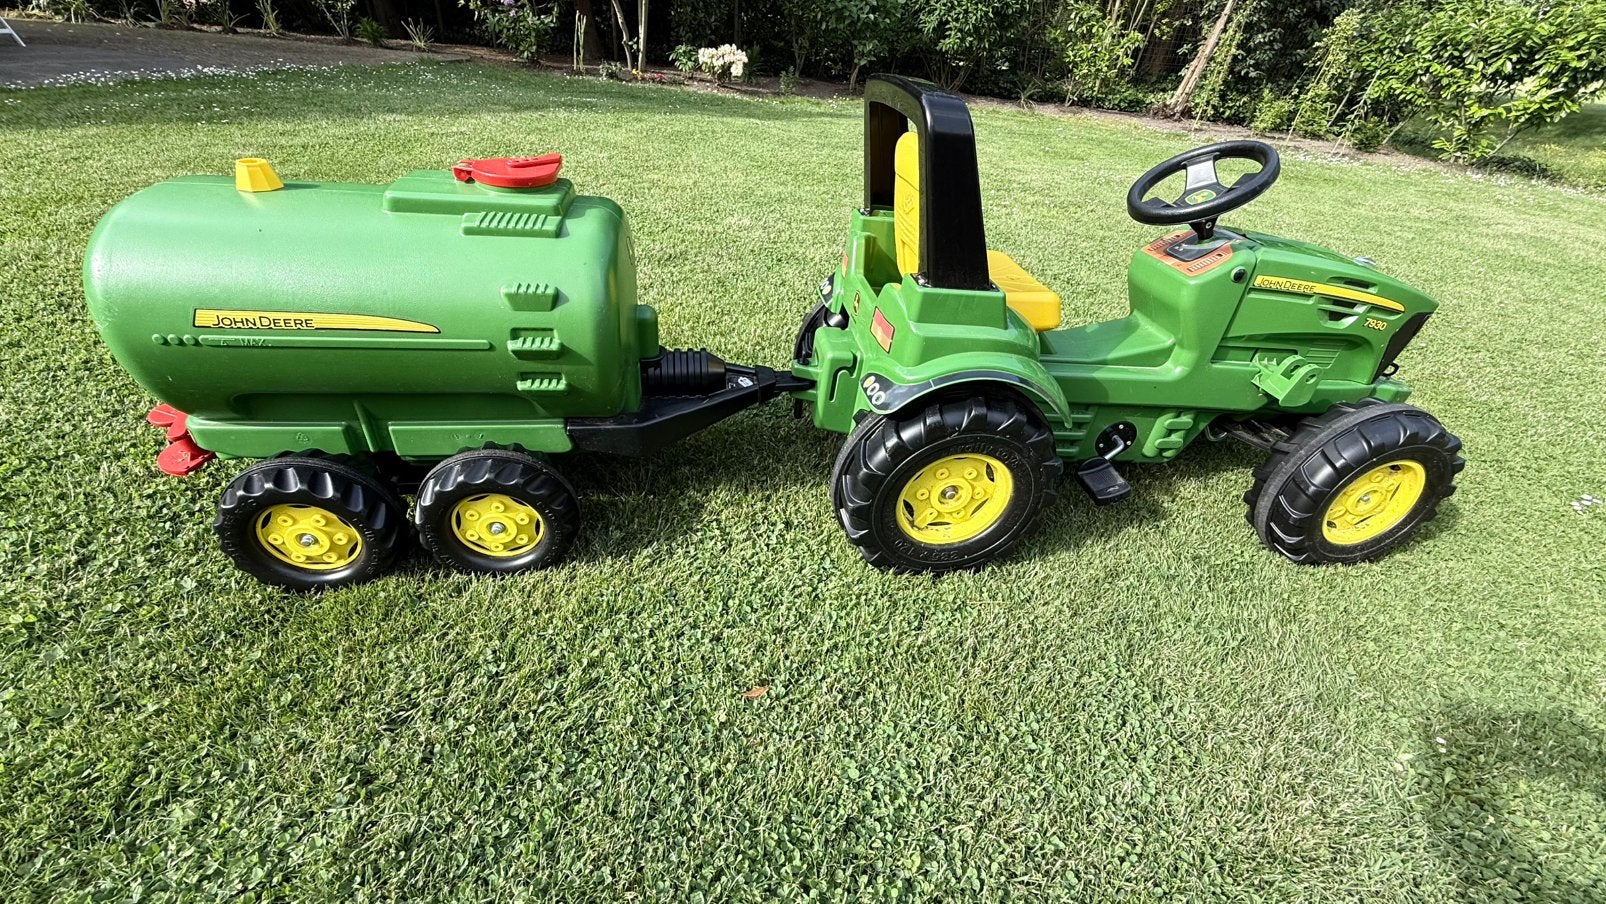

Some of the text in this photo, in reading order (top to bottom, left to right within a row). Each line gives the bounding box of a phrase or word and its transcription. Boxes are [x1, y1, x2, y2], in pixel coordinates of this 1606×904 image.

[1259, 277, 1316, 293] JOHN DEERE
[212, 315, 315, 328] JOHN DEERE
[1363, 317, 1387, 331] 7930
